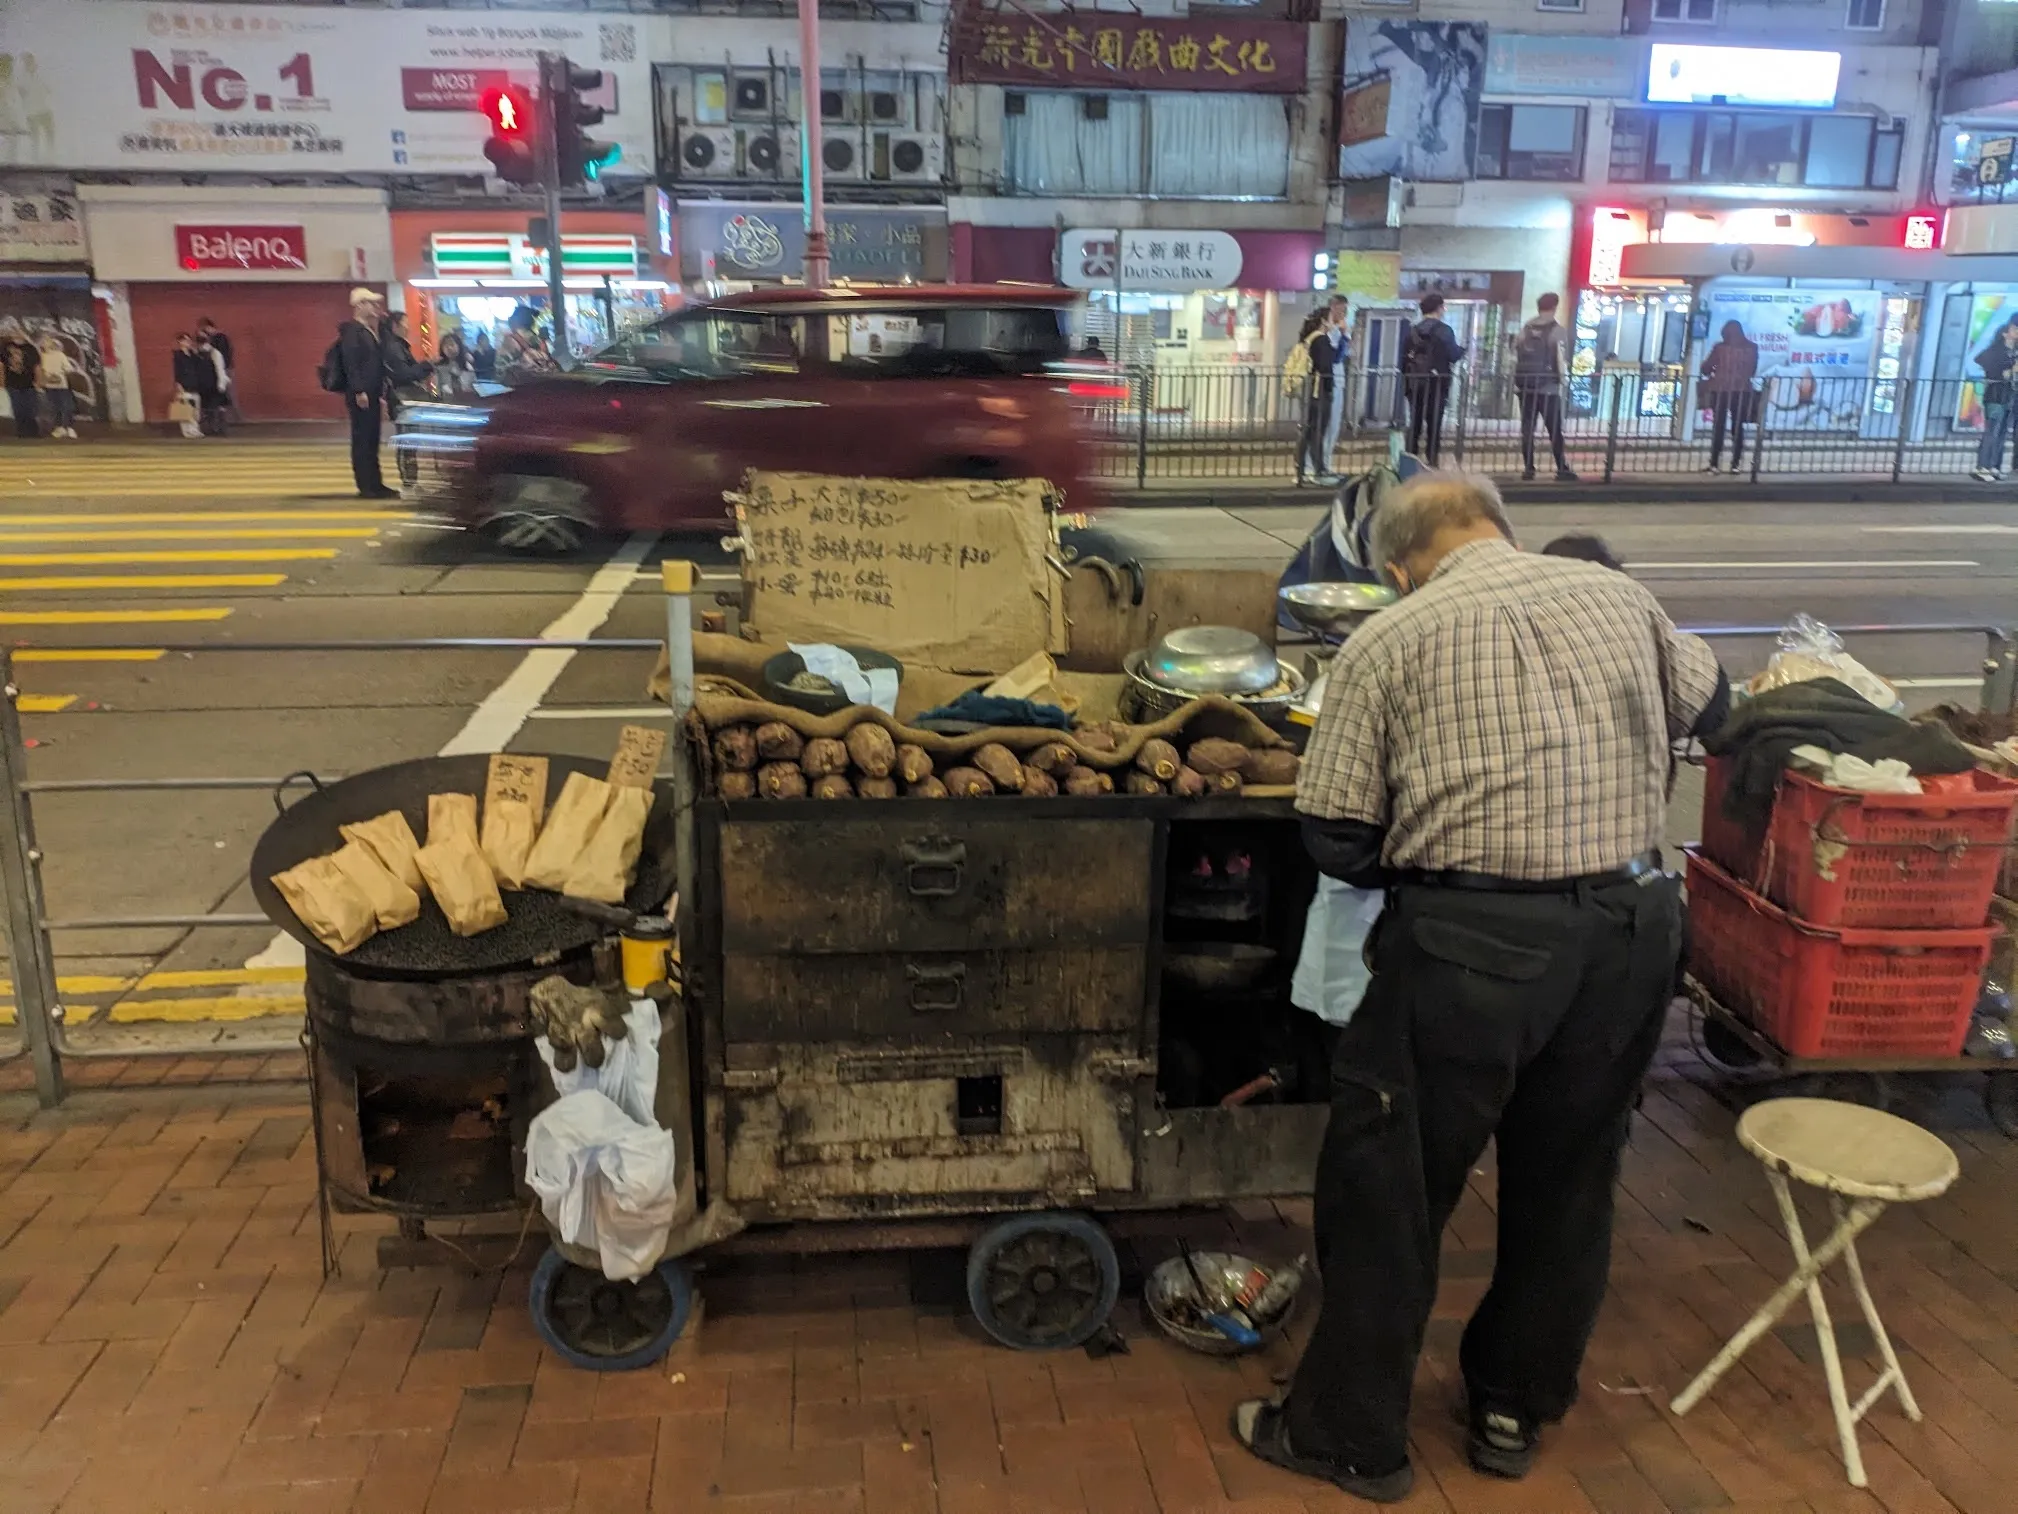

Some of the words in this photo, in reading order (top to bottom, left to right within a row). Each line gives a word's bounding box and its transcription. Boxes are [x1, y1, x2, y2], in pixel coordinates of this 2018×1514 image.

[189, 230, 293, 262] Baleno
[1123, 240, 1216, 262] 大新銀行
[1181, 266, 1214, 280] BANK
